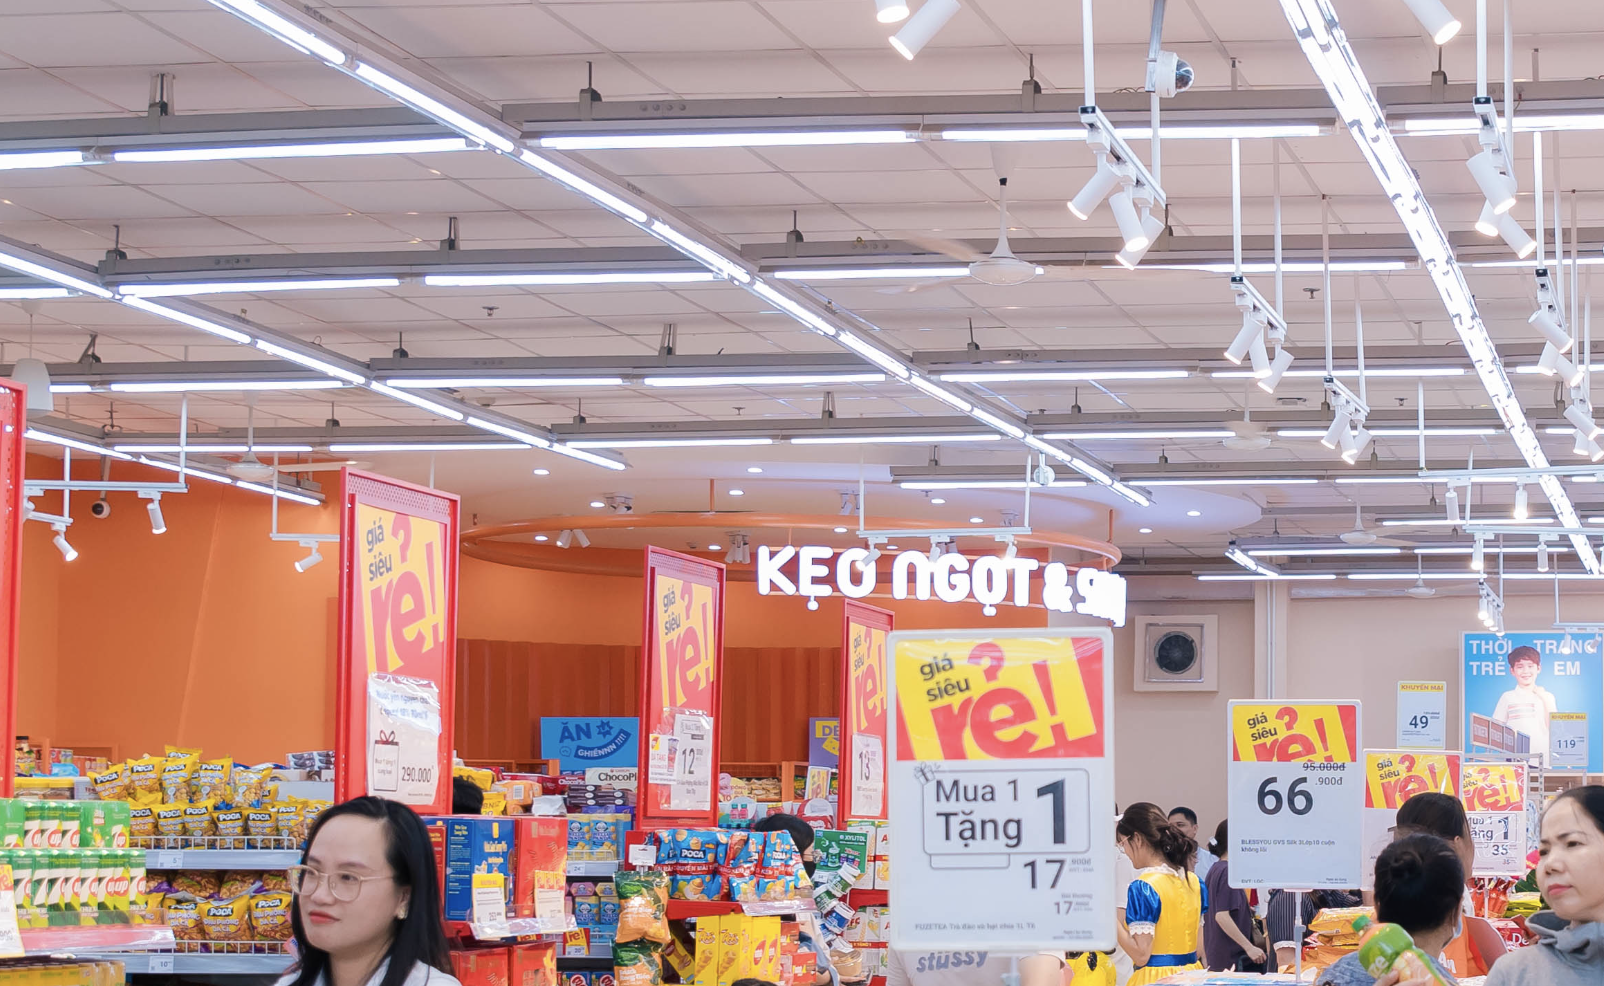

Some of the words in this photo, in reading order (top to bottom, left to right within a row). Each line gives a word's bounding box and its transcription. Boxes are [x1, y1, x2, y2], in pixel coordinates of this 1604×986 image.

[367, 517, 384, 553] giá
[369, 552, 392, 581] siêu
[1042, 562, 1074, 613] &
[1469, 637, 1512, 655] THỜI
[919, 653, 954, 681] giá
[1469, 657, 1507, 676] TRẺ
[1553, 661, 1581, 675] EM
[926, 678, 971, 702] siêu
[1247, 712, 1268, 729] giá
[1409, 715, 1429, 729] 49
[559, 722, 592, 743] ĂN
[1251, 727, 1277, 741] siêu
[1557, 739, 1576, 749] 119
[681, 748, 696, 774] 12
[1302, 763, 1346, 771] 95.000đ
[1377, 758, 1393, 771] giá
[402, 767, 432, 783] 290.000
[1379, 770, 1400, 781] siêu
[935, 779, 996, 802] Mua
[1008, 779, 1019, 801] 1
[1257, 776, 1314, 815] 66
[1315, 777, 1343, 786] .900đ
[218, 812, 243, 821] POCA
[248, 812, 271, 821] POCA
[936, 811, 1022, 847] Tặng
[1037, 778, 1066, 845] 1
[681, 850, 704, 858] POCA
[1023, 859, 1066, 889] 17
[210, 907, 233, 915] POCA
[1054, 901, 1073, 915] 17
